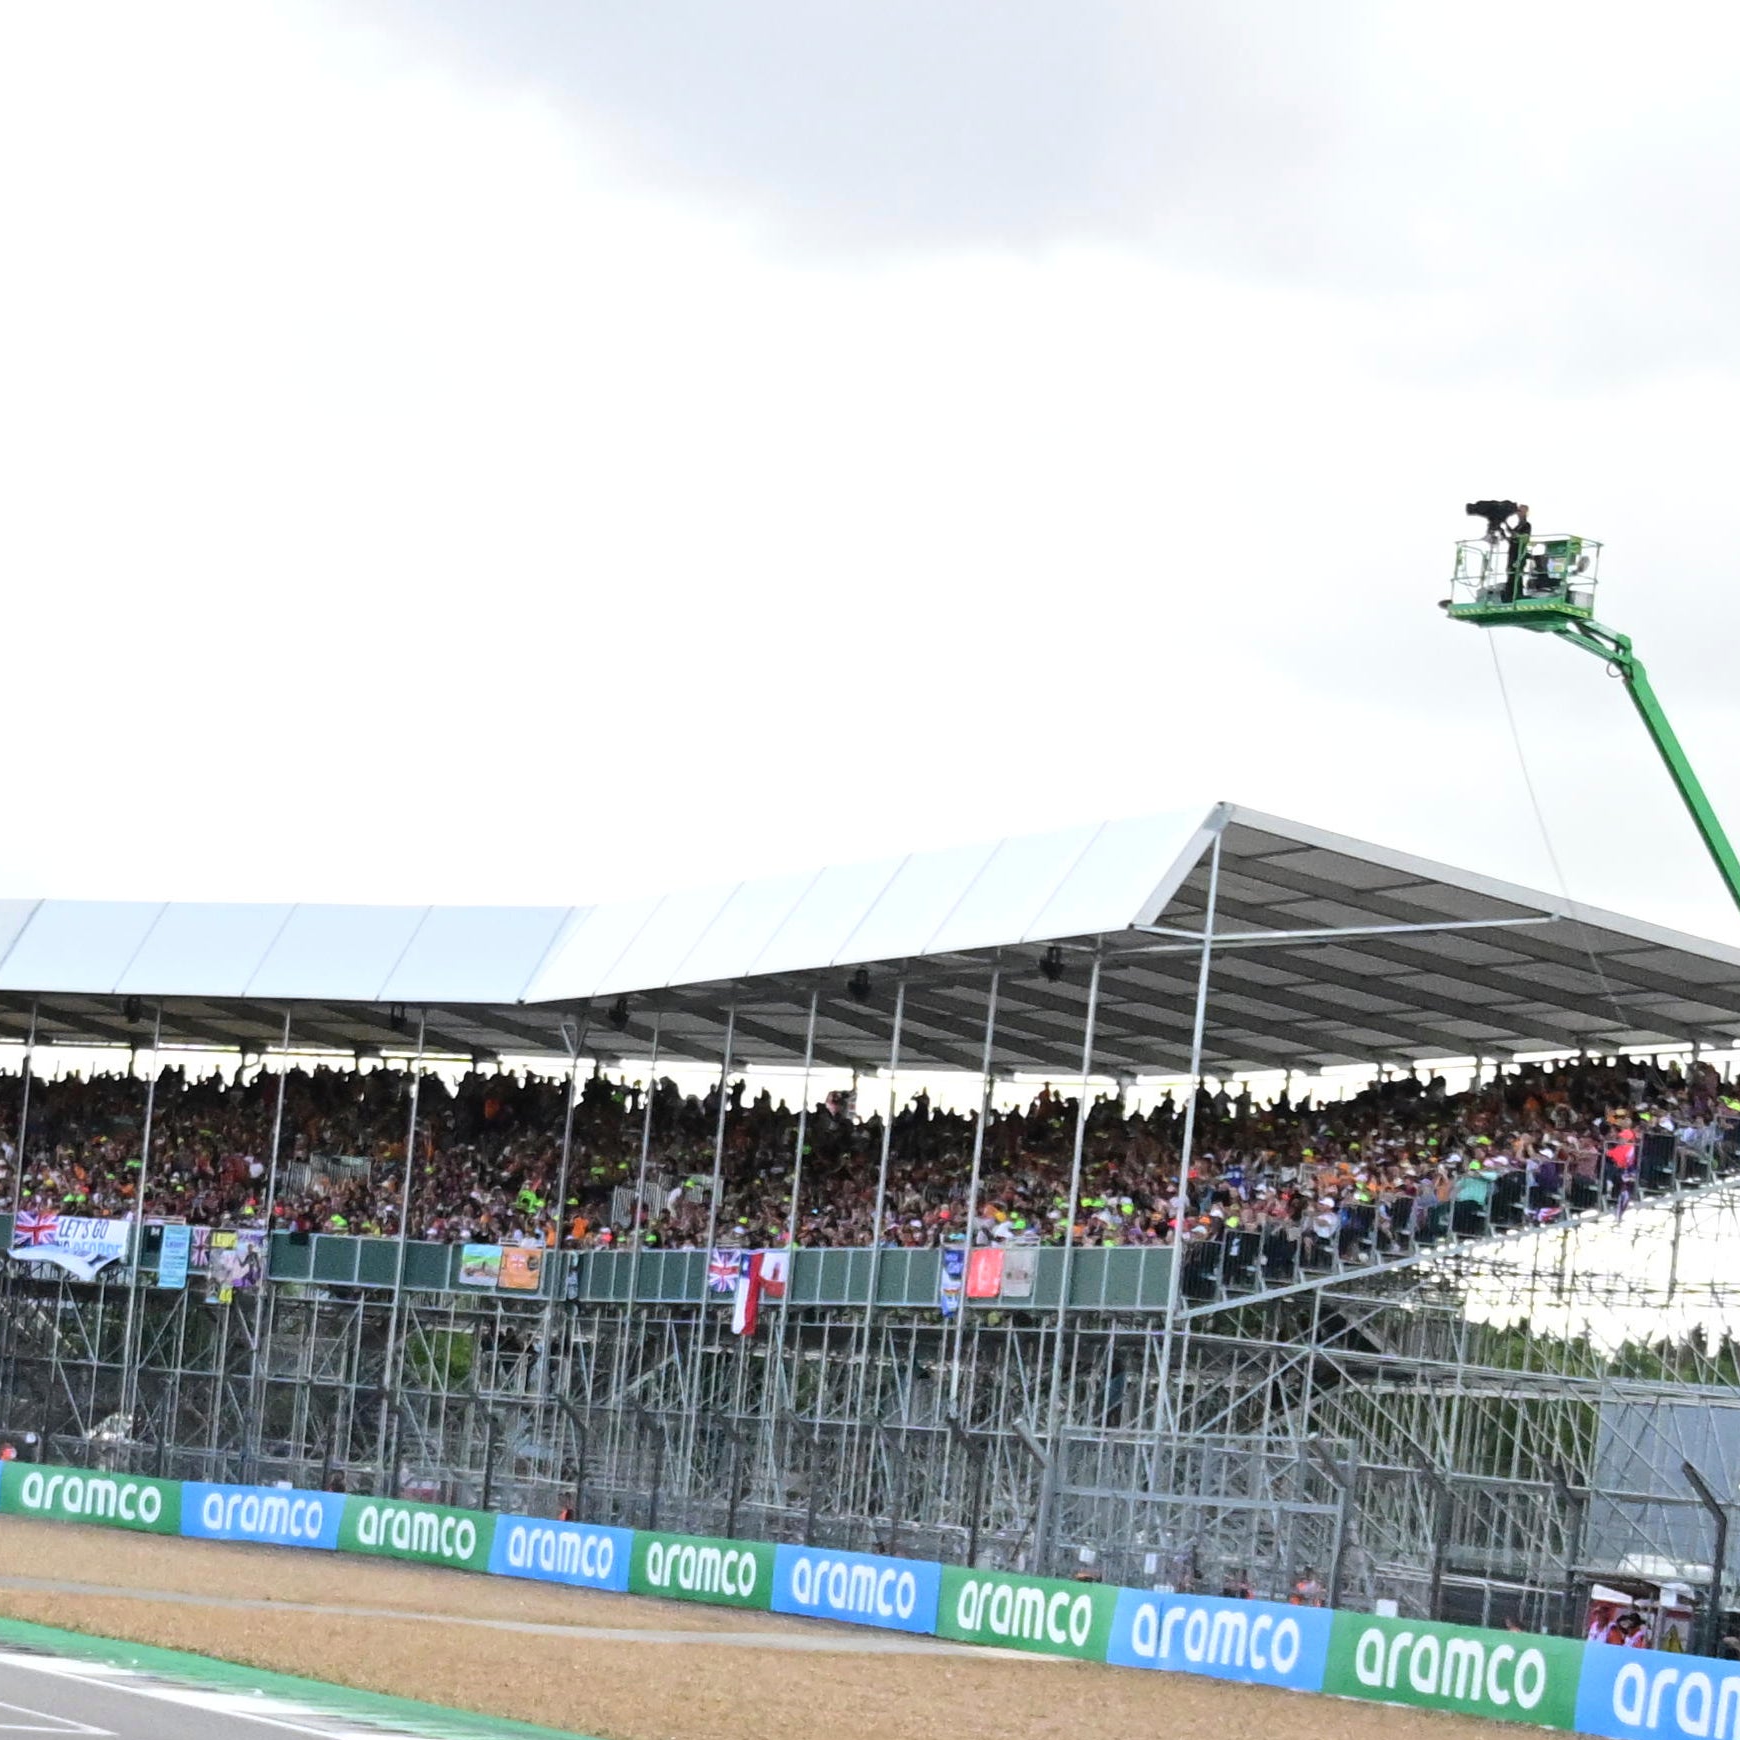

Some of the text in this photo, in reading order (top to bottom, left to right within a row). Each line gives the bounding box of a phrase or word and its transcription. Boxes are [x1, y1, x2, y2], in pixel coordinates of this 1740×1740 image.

[60, 1218, 109, 1239] LET'S GO
[22, 1471, 162, 1523] aramco
[203, 1493, 323, 1538] aramco
[357, 1504, 476, 1560] aramco
[509, 1526, 613, 1579] aramco
[646, 1541, 757, 1597] aramco
[792, 1558, 915, 1618] aramco
[957, 1579, 1093, 1647] aramco
[1132, 1603, 1300, 1674] aramco
[1355, 1627, 1547, 1710] aramco
